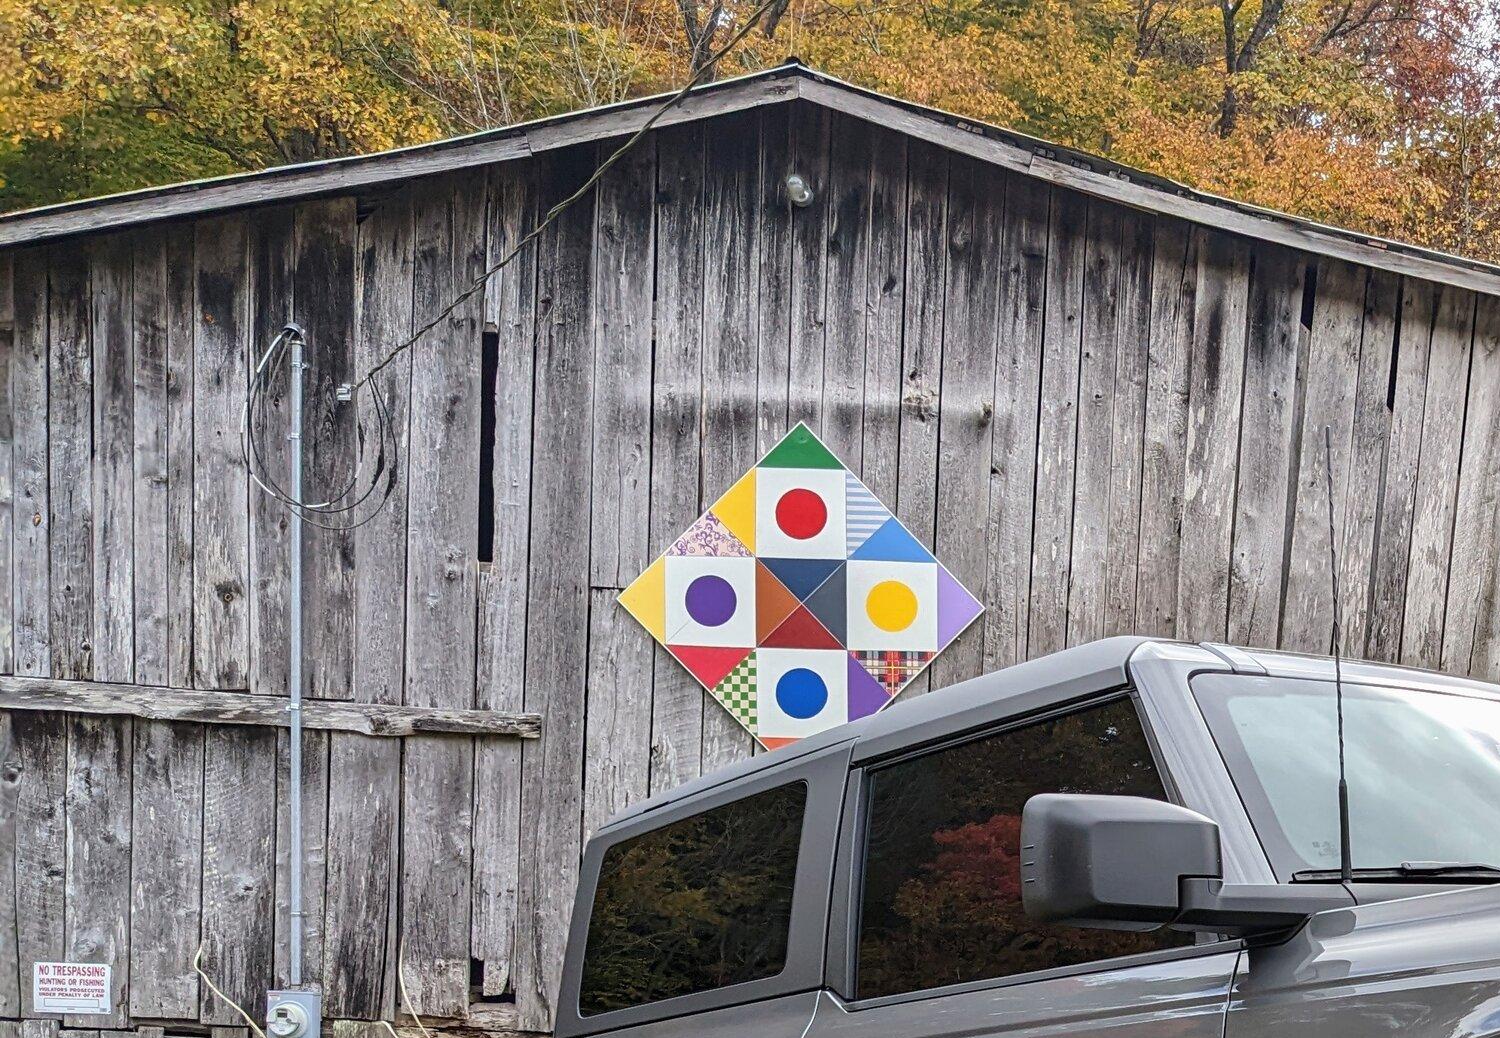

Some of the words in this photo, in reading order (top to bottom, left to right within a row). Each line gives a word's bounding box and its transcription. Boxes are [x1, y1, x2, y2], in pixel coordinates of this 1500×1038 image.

[39, 965, 49, 976] NO
[53, 965, 106, 977] TRESPASSING
[39, 978, 66, 986] HUNTING
[68, 978, 77, 986] OR
[79, 979, 105, 987] FISHING
